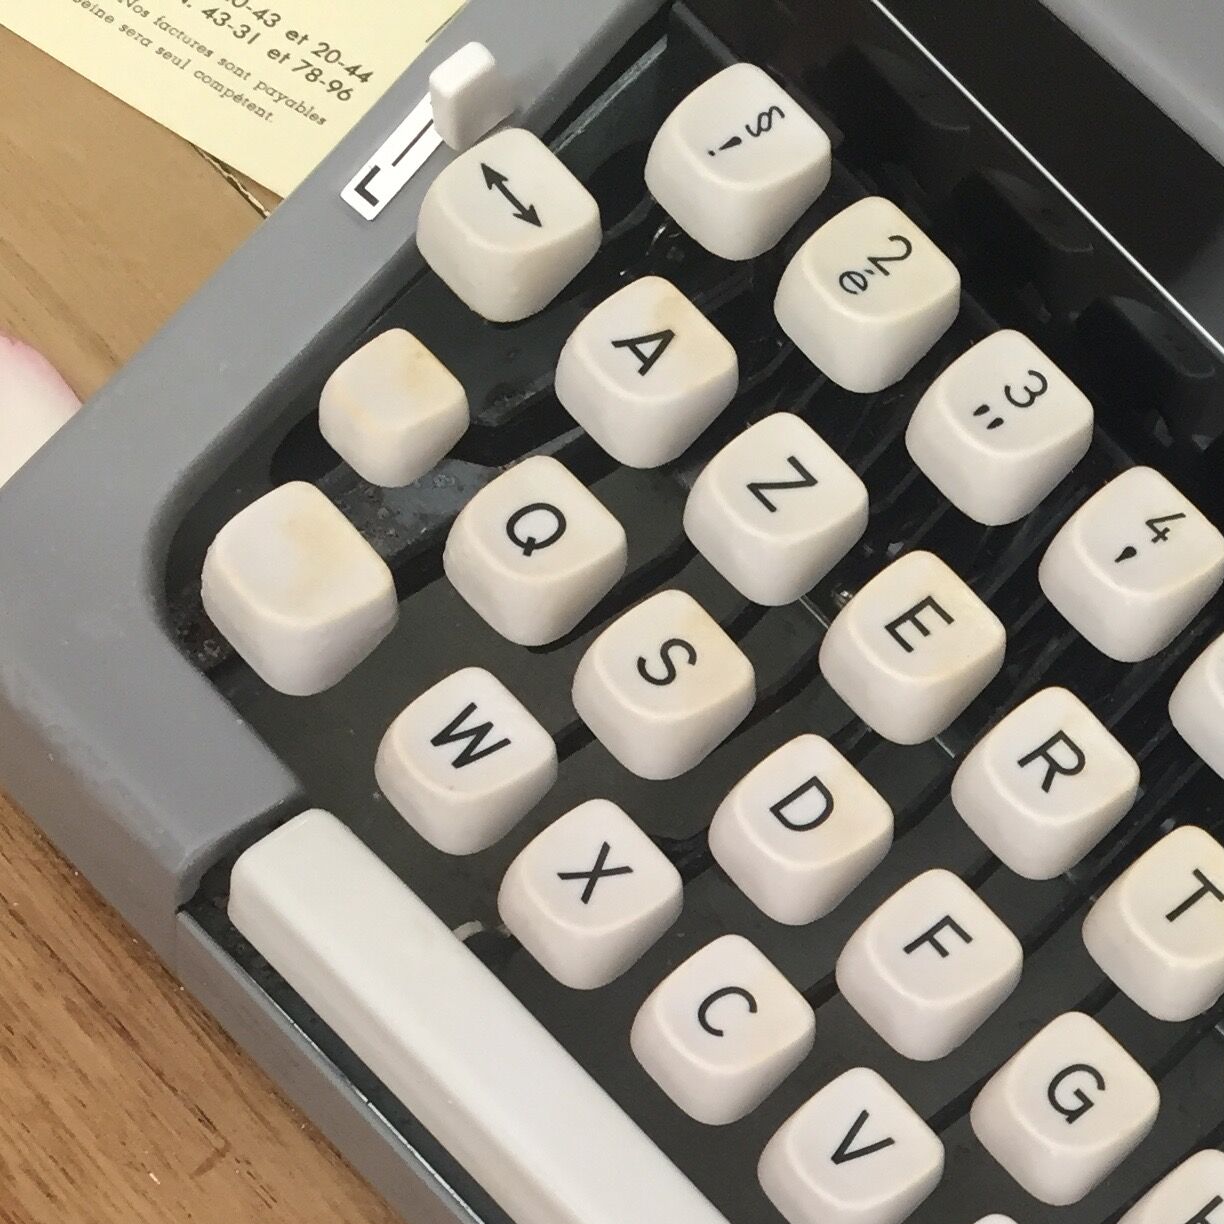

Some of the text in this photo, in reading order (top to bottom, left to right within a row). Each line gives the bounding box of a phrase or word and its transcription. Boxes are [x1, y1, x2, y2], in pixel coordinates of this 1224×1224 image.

[73, 0, 115, 24] eine
[119, 24, 153, 47] sera
[155, 46, 191, 70] seul
[201, 7, 354, 102] 43-31 et 78-96
[226, 0, 374, 83] 0-43 et 20-44
[153, 15, 214, 58] factures
[217, 58, 251, 81] sont
[253, 80, 327, 126] payables
[866, 235, 913, 276] 2
[612, 329, 675, 376] A
[1004, 370, 1047, 408] 3
[747, 456, 818, 512] Z
[506, 503, 566, 556] Q
[1145, 512, 1187, 543] 4
[885, 596, 954, 653] E
[637, 639, 697, 686] S
[430, 702, 511, 769] W
[1018, 730, 1085, 793] R
[770, 776, 834, 832] D
[557, 842, 633, 904] X
[903, 915, 972, 958] F
[698, 987, 757, 1037] C
[1048, 1064, 1105, 1124] G
[831, 1110, 895, 1165] V
